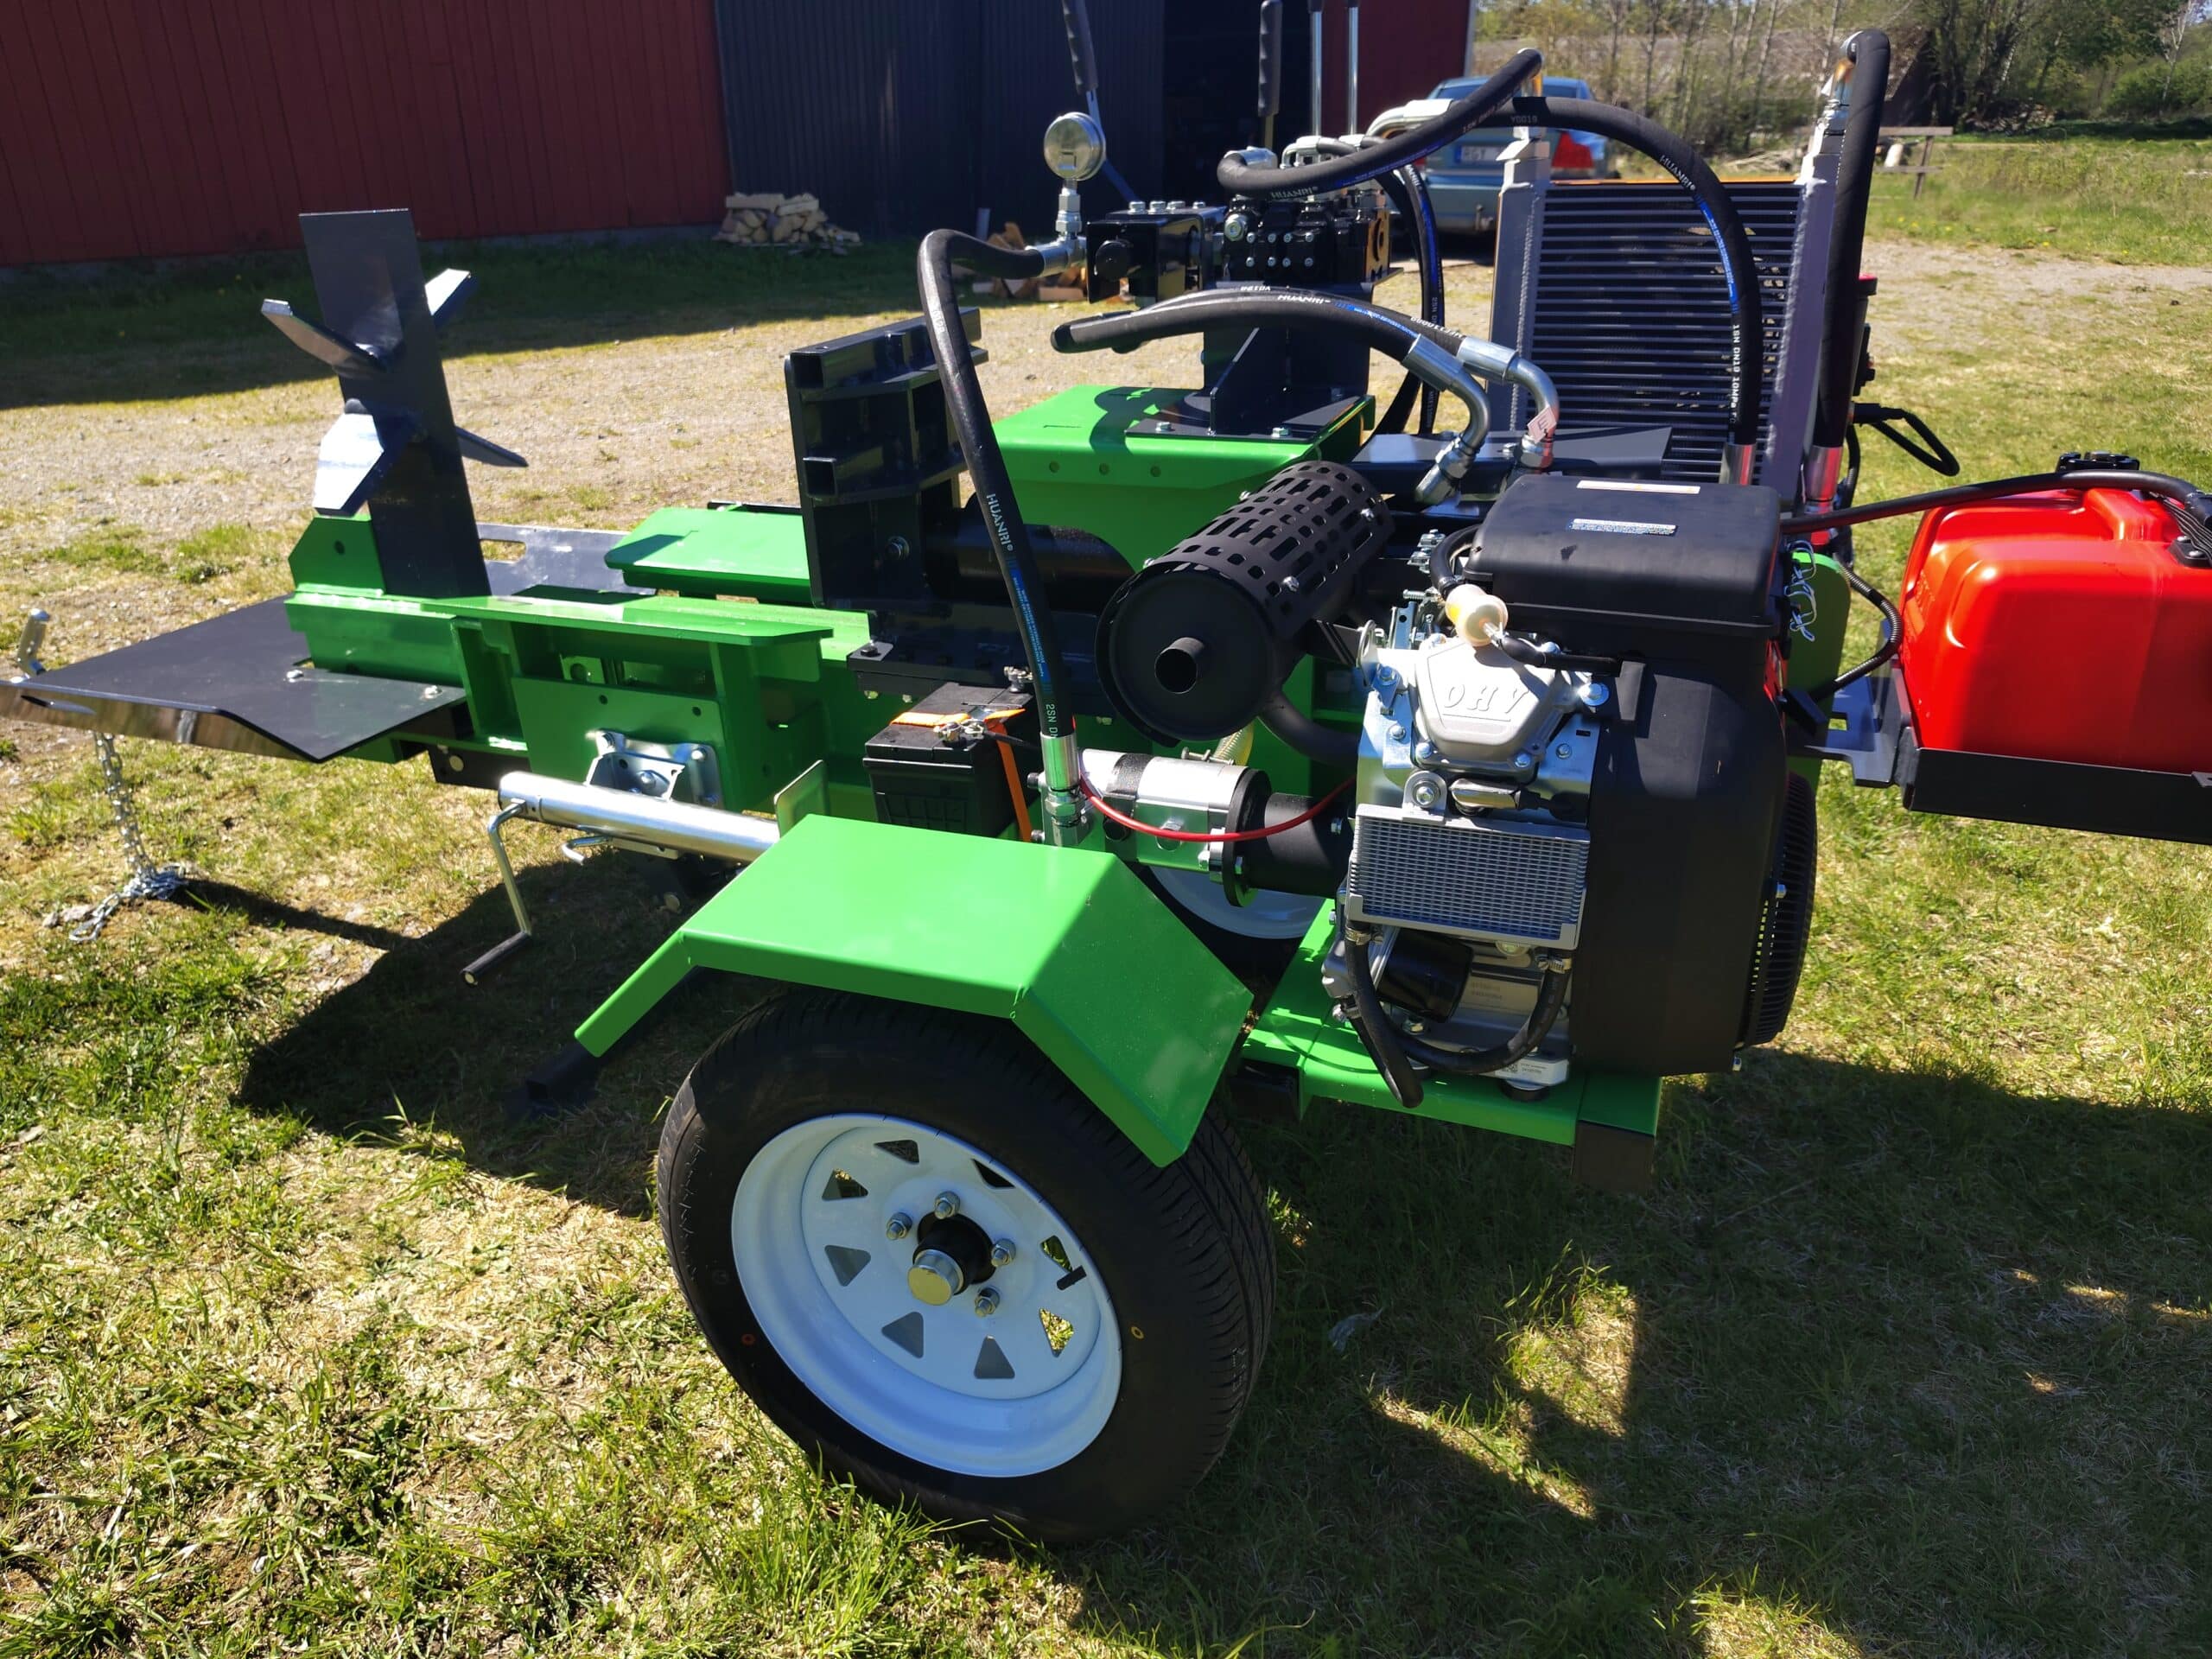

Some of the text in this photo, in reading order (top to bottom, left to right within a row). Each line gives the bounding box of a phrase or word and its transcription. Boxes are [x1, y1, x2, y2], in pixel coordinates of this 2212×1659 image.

[1732, 324, 1741, 343] 1SN
[1732, 346, 1741, 372] DN10
[987, 493, 1011, 545] HUANRI
[1442, 683, 1529, 715] OHV
[1046, 703, 1057, 722] 2SN
